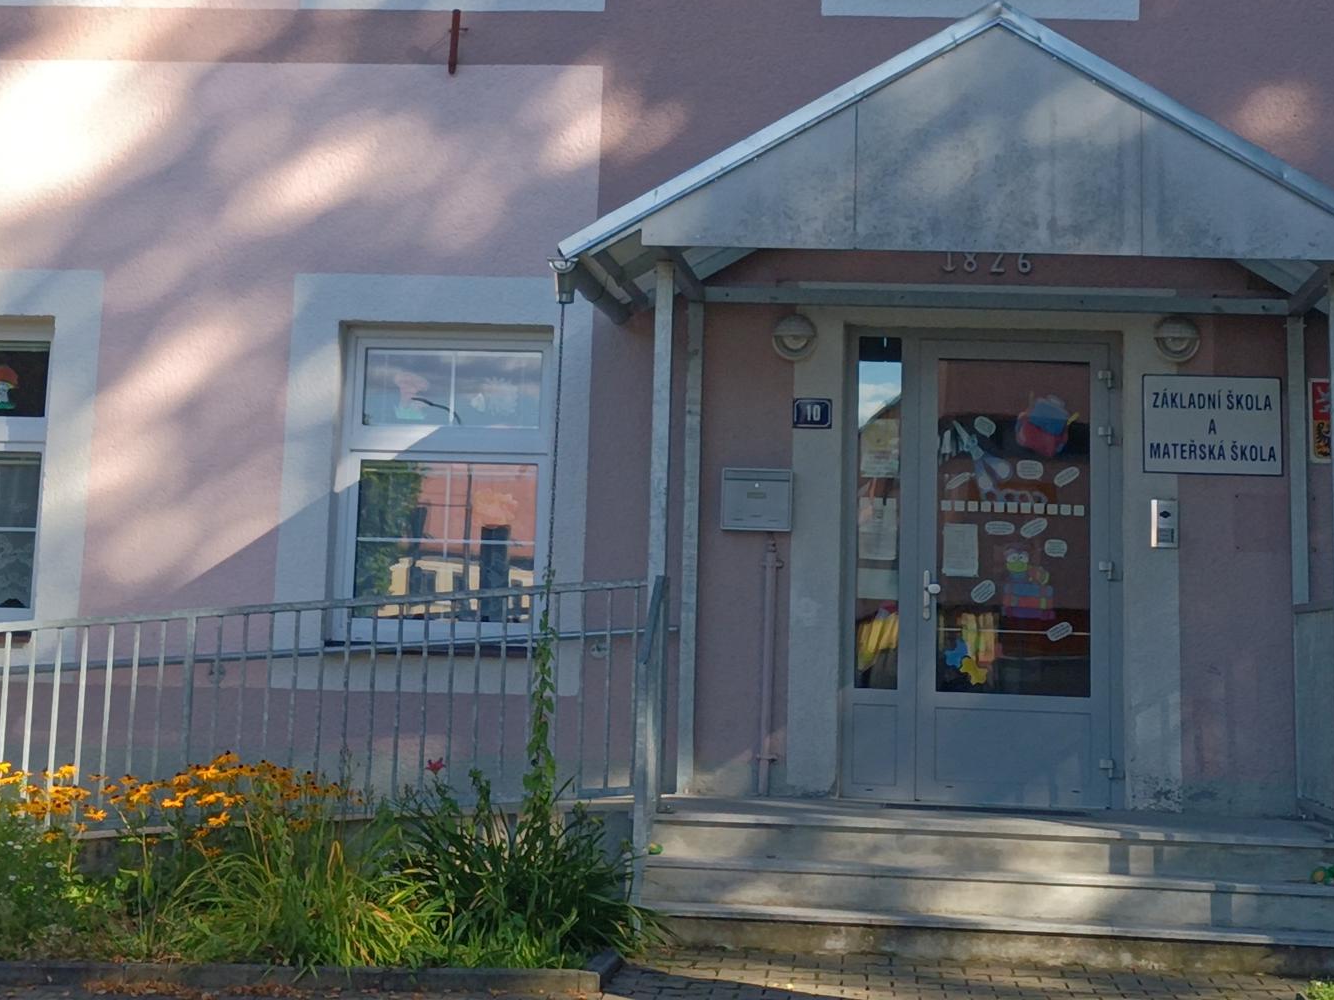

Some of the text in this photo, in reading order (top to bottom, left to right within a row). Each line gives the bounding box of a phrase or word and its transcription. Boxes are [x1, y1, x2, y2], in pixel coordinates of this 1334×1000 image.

[1152, 388, 1272, 411] ZÁKLADNÍ ŠKOLA
[807, 404, 821, 421] 10
[1208, 418, 1217, 435] A
[1149, 440, 1276, 462] MATEŘSKÁ ŠKOLA
